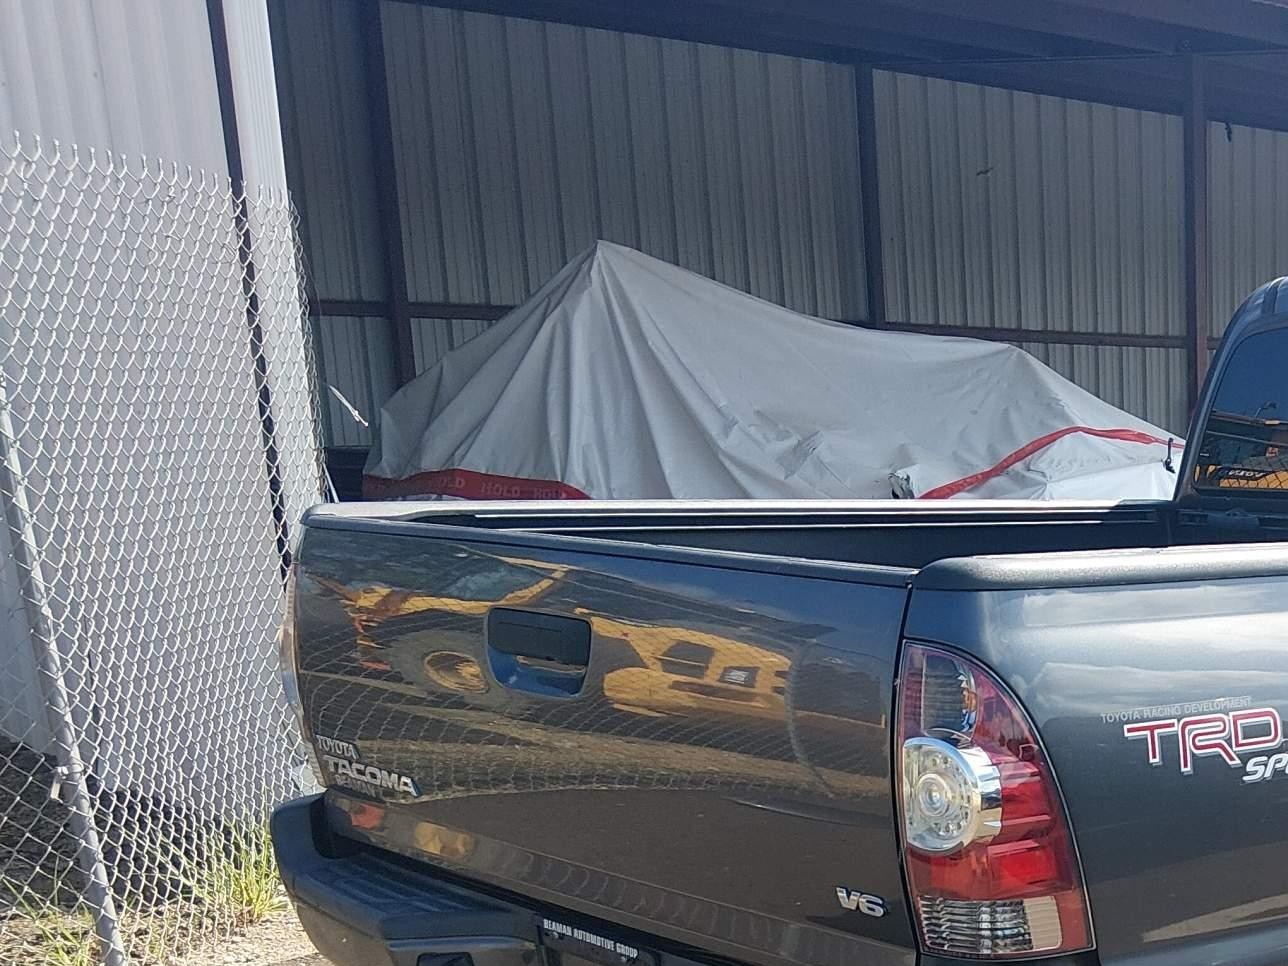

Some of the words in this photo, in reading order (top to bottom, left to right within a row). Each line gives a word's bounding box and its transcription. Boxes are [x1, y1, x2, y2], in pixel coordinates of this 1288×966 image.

[1100, 709, 1141, 724] TOYOTA
[1143, 703, 1182, 719] RACING
[1184, 696, 1251, 714] DEVELOPMENT
[316, 734, 358, 760] TOYOTA
[1124, 707, 1282, 774] TRD
[323, 754, 418, 797] TACOMA
[836, 887, 885, 917] V6
[543, 918, 572, 937] BEAMAN
[572, 928, 616, 951] AUTOMOTIVE
[616, 942, 639, 959] GROUP
